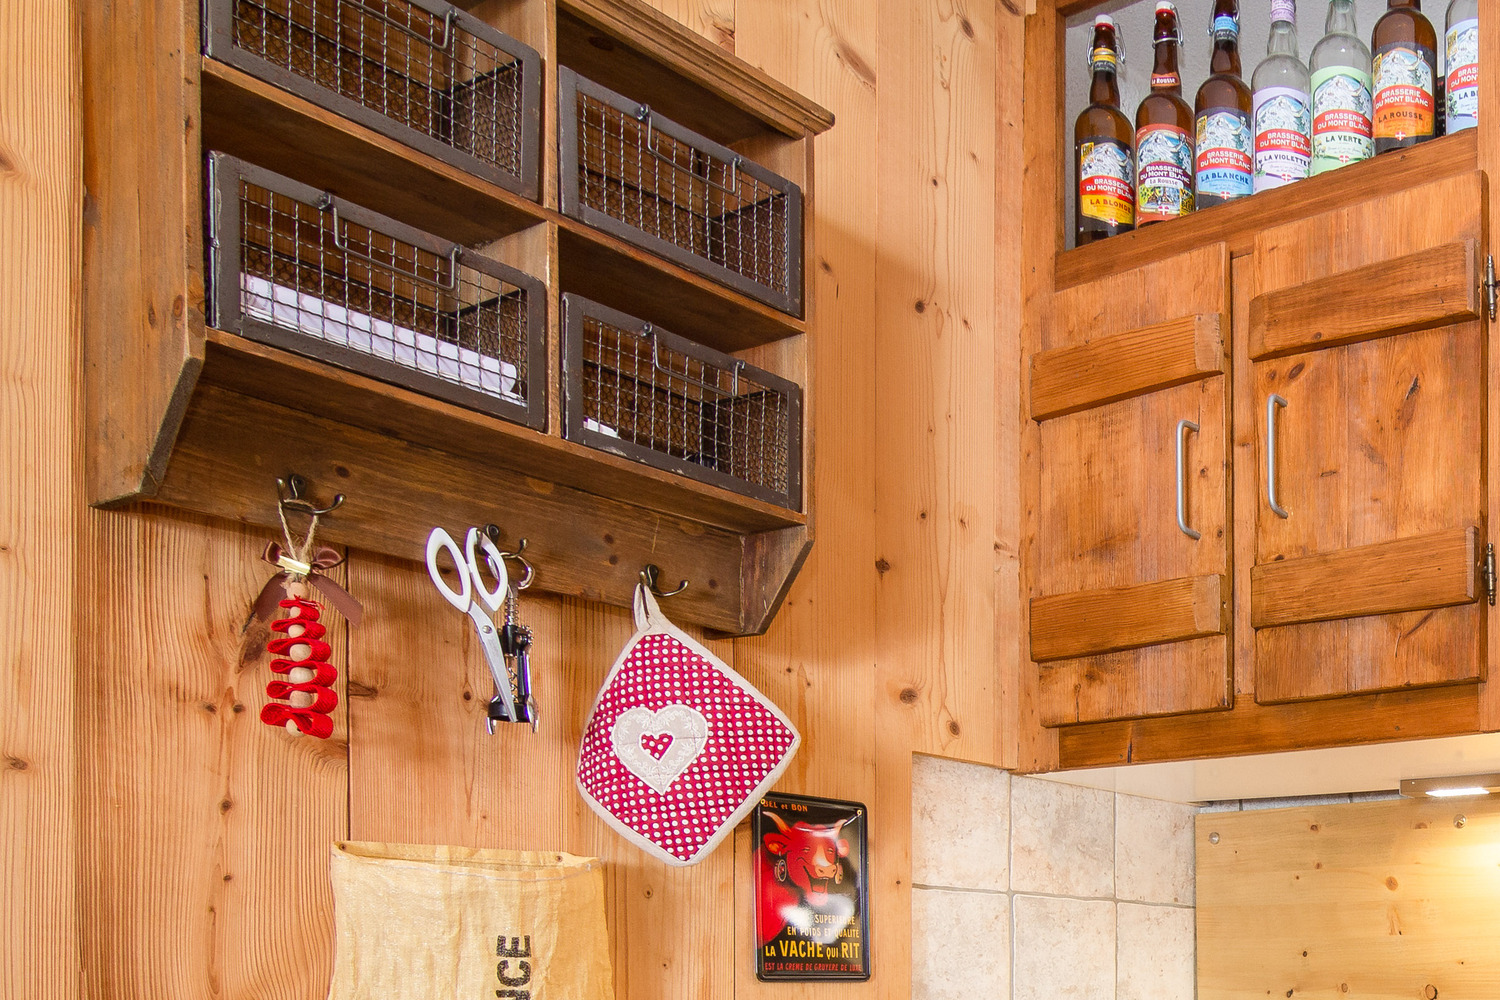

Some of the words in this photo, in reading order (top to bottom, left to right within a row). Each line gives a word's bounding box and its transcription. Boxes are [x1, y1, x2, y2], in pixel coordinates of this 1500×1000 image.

[1450, 79, 1460, 88] DU
[1381, 88, 1421, 99] BRASSERIE
[1458, 92, 1469, 100] LA
[1375, 101, 1384, 109] DU
[1384, 96, 1403, 104] MONT
[1405, 96, 1428, 107] BLANC
[1325, 112, 1363, 123] BRASSERIE
[1378, 114, 1387, 123] LA
[1389, 111, 1423, 120] ROUSSE
[1317, 122, 1326, 130] DU
[1349, 120, 1370, 134] BLANC
[1267, 132, 1305, 145] BRASSERIE
[1325, 135, 1336, 143] LA
[1337, 135, 1362, 145] VERTE
[1291, 140, 1310, 153] BLANC
[1206, 150, 1244, 161] BRASSERIE
[1274, 154, 1307, 167] VIOLETTE
[1145, 165, 1183, 175] BRASSERIE
[1229, 158, 1251, 171] BLANC
[1201, 174, 1210, 182] LA
[1211, 172, 1249, 185] BLANCHE
[1086, 184, 1096, 192] DU
[1094, 178, 1130, 193] BRASSERIE
[1103, 199, 1132, 213] BLONDE
[791, 803, 808, 812] BON
[787, 926, 797, 936] EN
[800, 927, 822, 937] POIDS
[824, 927, 832, 937] ET
[765, 945, 776, 957] LA
[779, 940, 824, 958] VACHE
[826, 947, 839, 960] QUI
[841, 942, 860, 959] RIT
[764, 962, 775, 971] EST
[776, 963, 784, 971] LA
[805, 963, 813, 971] DE
[840, 963, 848, 971] DE
